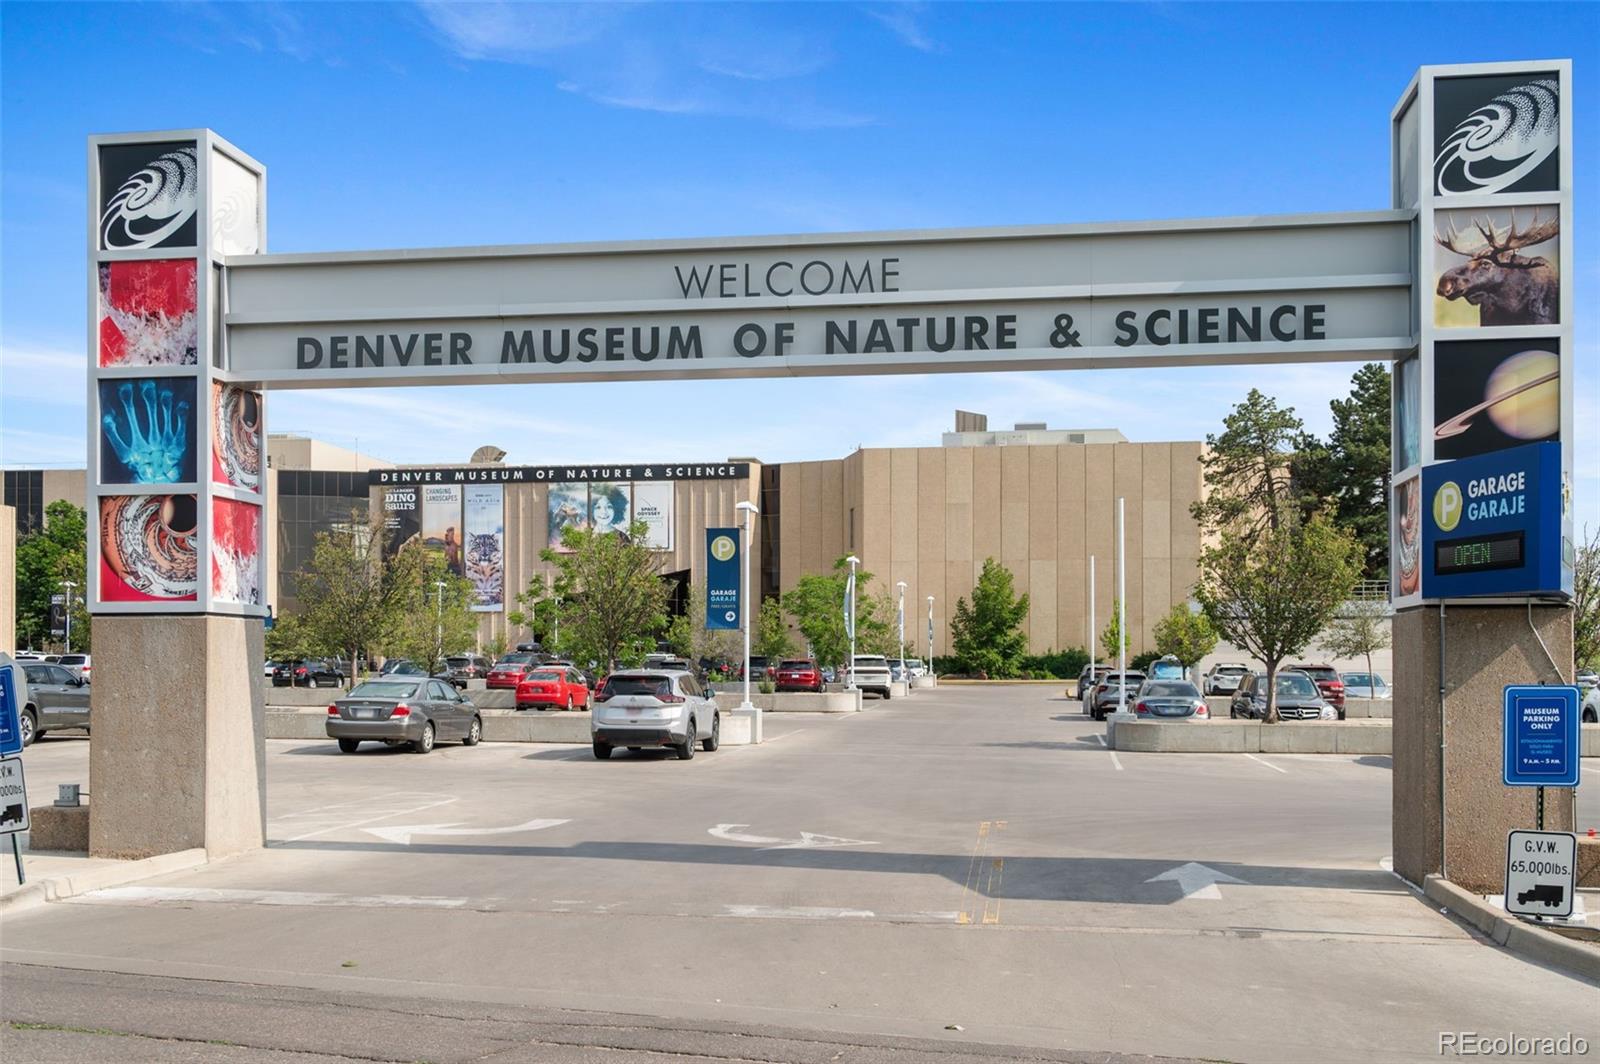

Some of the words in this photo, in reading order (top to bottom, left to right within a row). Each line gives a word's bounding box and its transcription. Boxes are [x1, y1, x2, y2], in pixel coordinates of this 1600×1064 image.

[674, 258, 900, 299] WELCOME
[296, 332, 473, 369] DENVER
[500, 325, 703, 364] MUSEUM
[733, 322, 795, 358] OF
[825, 315, 1017, 354] NATURE
[1049, 313, 1083, 348] &
[1114, 304, 1326, 346] SCIENCE
[380, 472, 443, 482] DENVER
[454, 471, 523, 481] MUSEUM
[536, 470, 554, 479] OF
[567, 468, 632, 479] NATURE
[644, 468, 653, 477] &
[665, 466, 736, 477] SCIENCE
[425, 487, 452, 495] CHANGING
[1467, 471, 1526, 498] GARAGE
[385, 493, 416, 502] DINO
[385, 502, 416, 511] saurs
[1441, 487, 1458, 524] P
[1467, 495, 1526, 521] GARAJE
[717, 540, 731, 557] P
[1454, 542, 1491, 566] OPEN
[1524, 840, 1560, 854] G.V.W.
